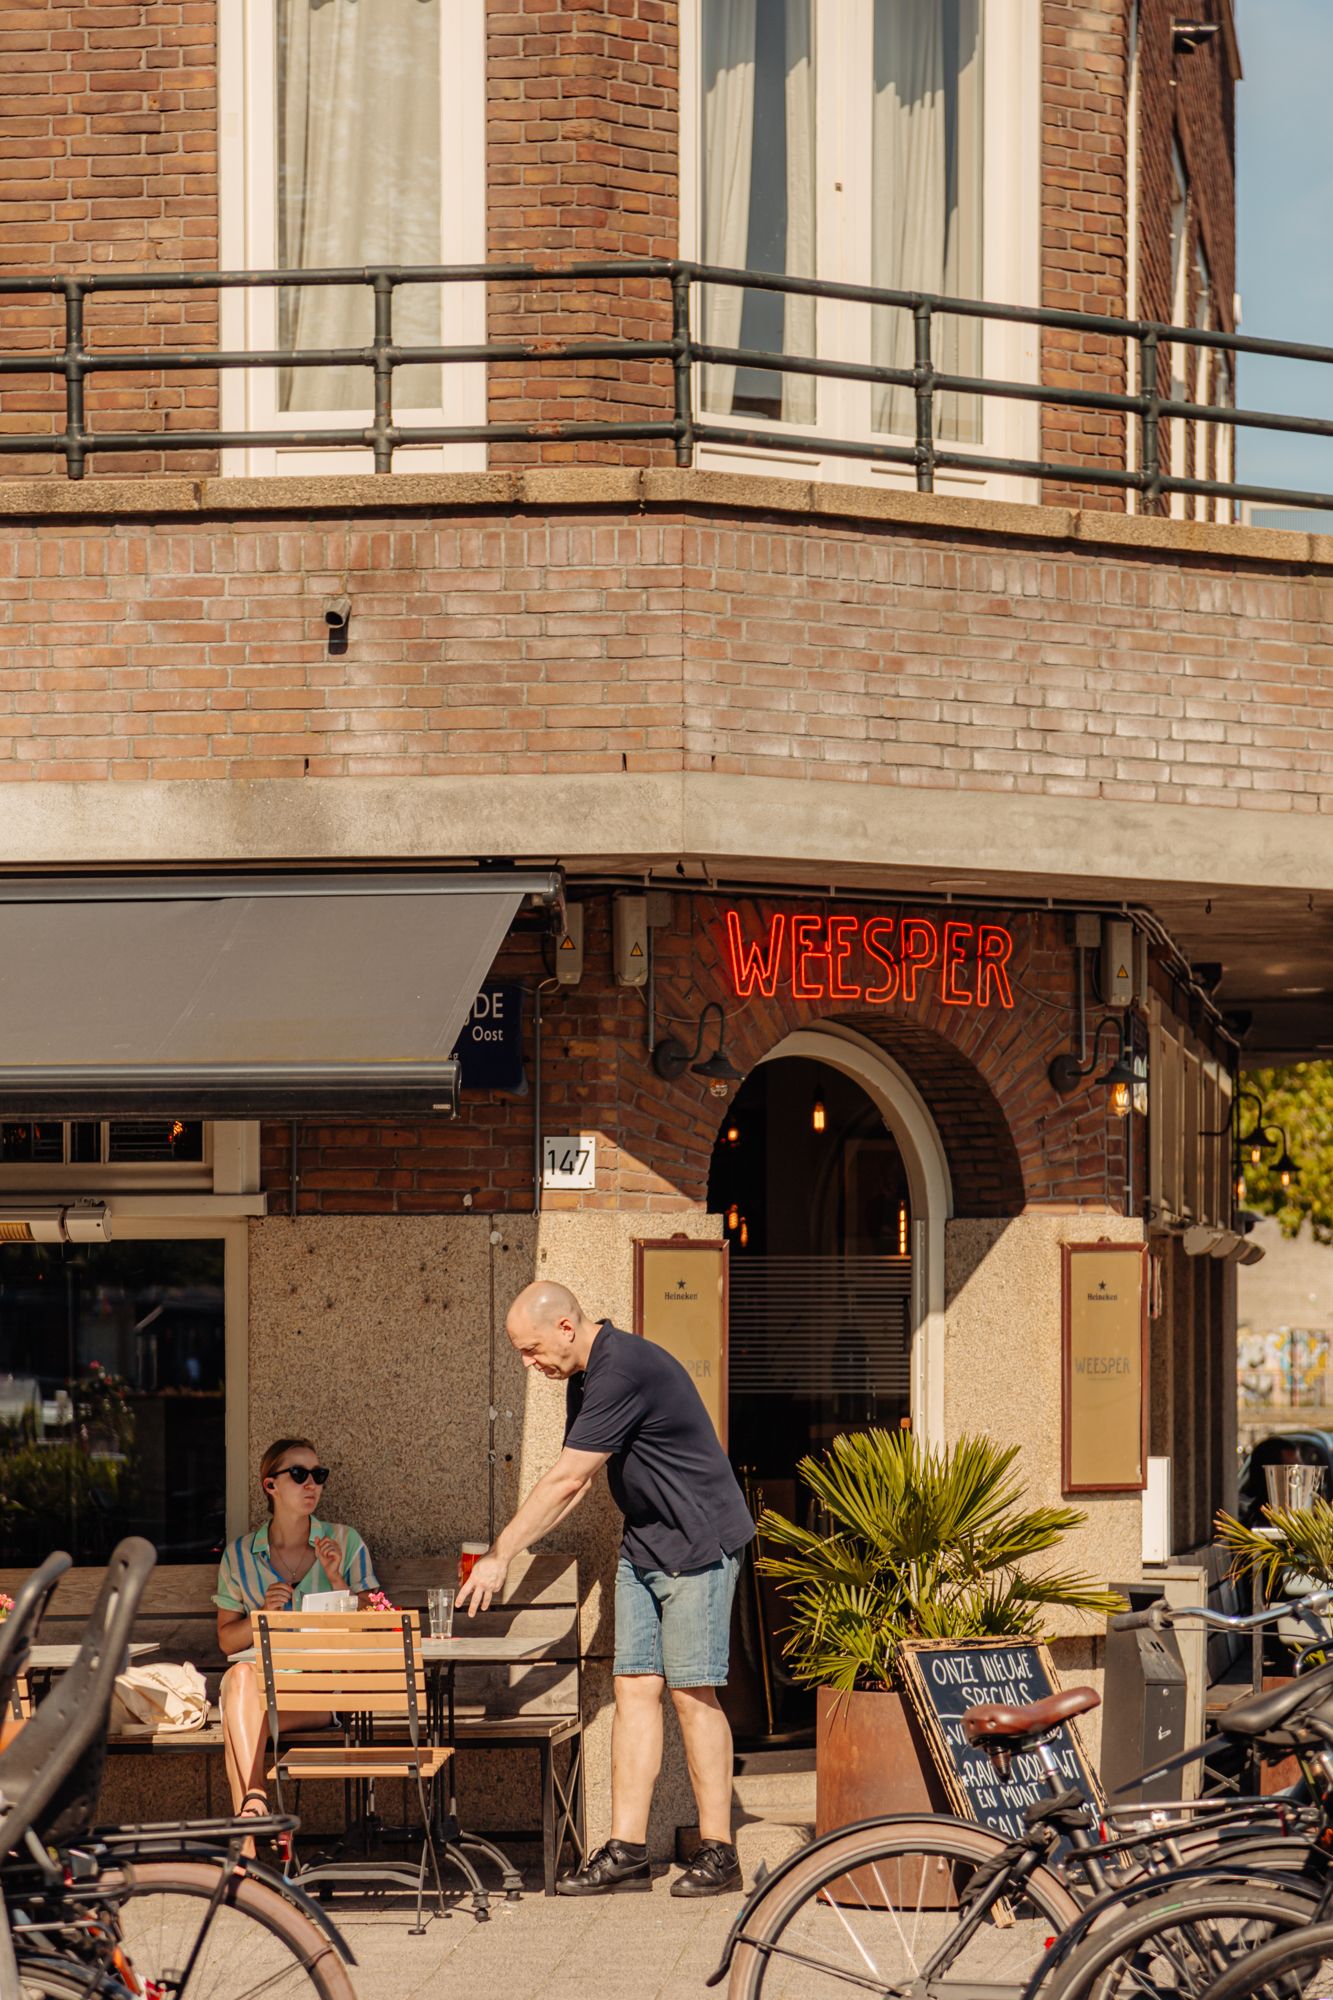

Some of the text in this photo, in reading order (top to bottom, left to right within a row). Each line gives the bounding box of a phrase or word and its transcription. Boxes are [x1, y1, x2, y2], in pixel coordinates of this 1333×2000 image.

[726, 911, 1013, 1008] WEESPER
[472, 1026, 503, 1041] Oost
[547, 1150, 590, 1175] 147
[664, 1291, 698, 1300] Heineken
[1087, 1293, 1118, 1301] Heineken
[685, 1360, 712, 1378] PER
[1074, 1357, 1130, 1375] WEESPER
[932, 1652, 1034, 1685] ONZE NIEUWE
[975, 1782, 1041, 1809] EN MUNT
